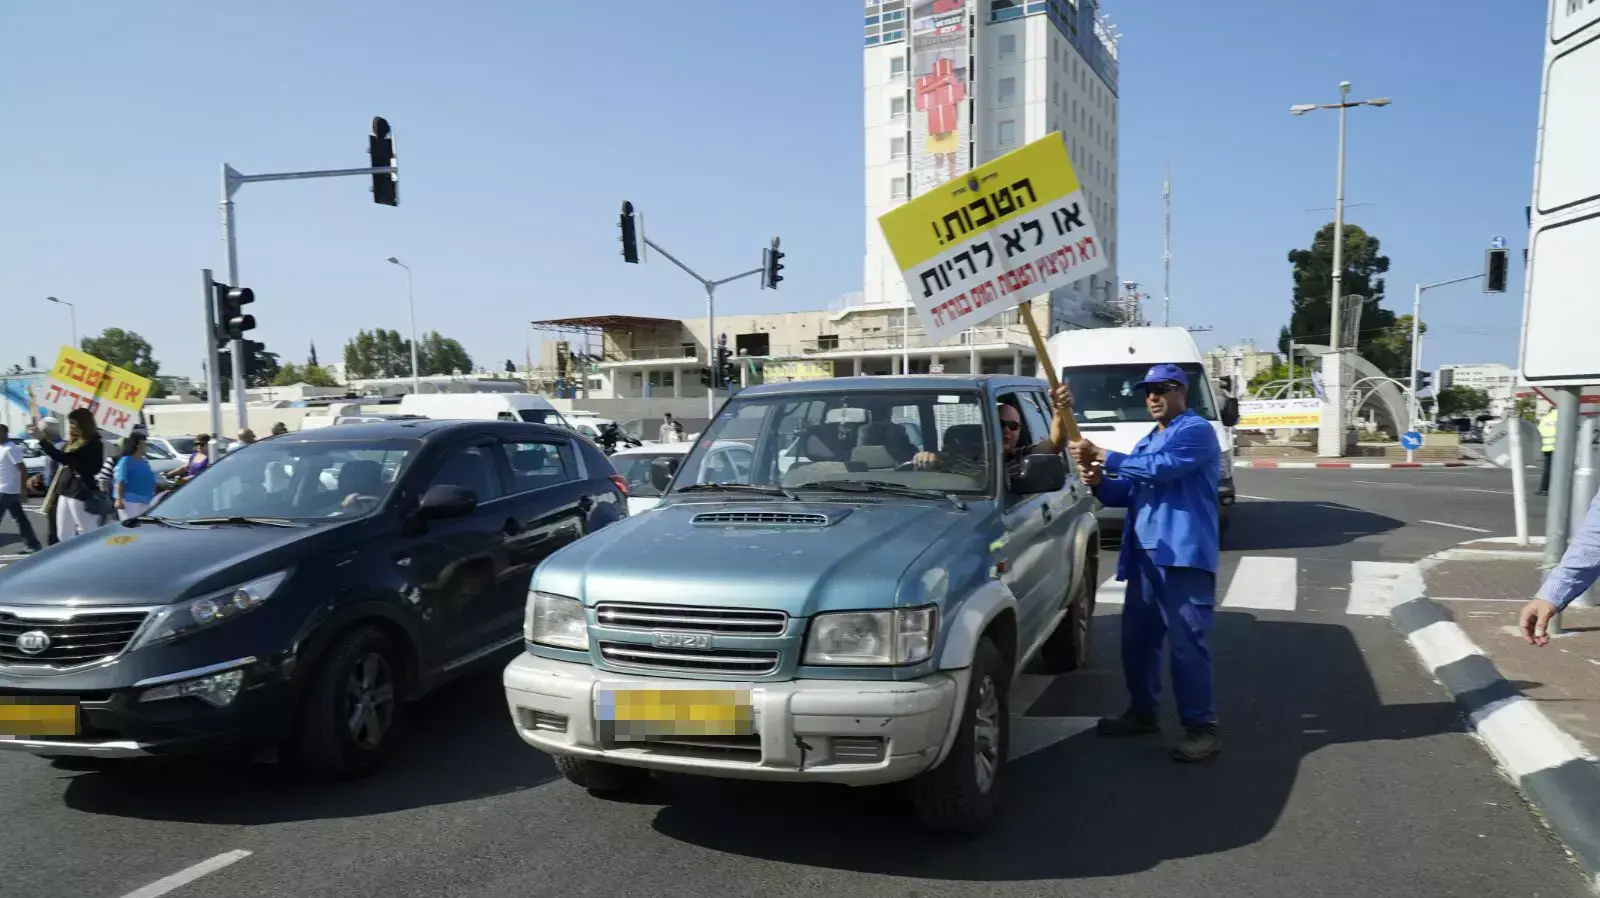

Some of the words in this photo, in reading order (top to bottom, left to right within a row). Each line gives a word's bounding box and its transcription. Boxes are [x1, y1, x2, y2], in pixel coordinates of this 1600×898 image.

[931, 177, 1039, 245] הטבות!
[1051, 202, 1086, 236] או
[1000, 218, 1043, 258] לא
[1076, 236, 1097, 262] לא
[919, 241, 994, 298] להיות
[58, 357, 114, 392] הטבה
[113, 380, 142, 404] אין
[102, 407, 132, 430] אין
[20, 636, 44, 649] KIA
